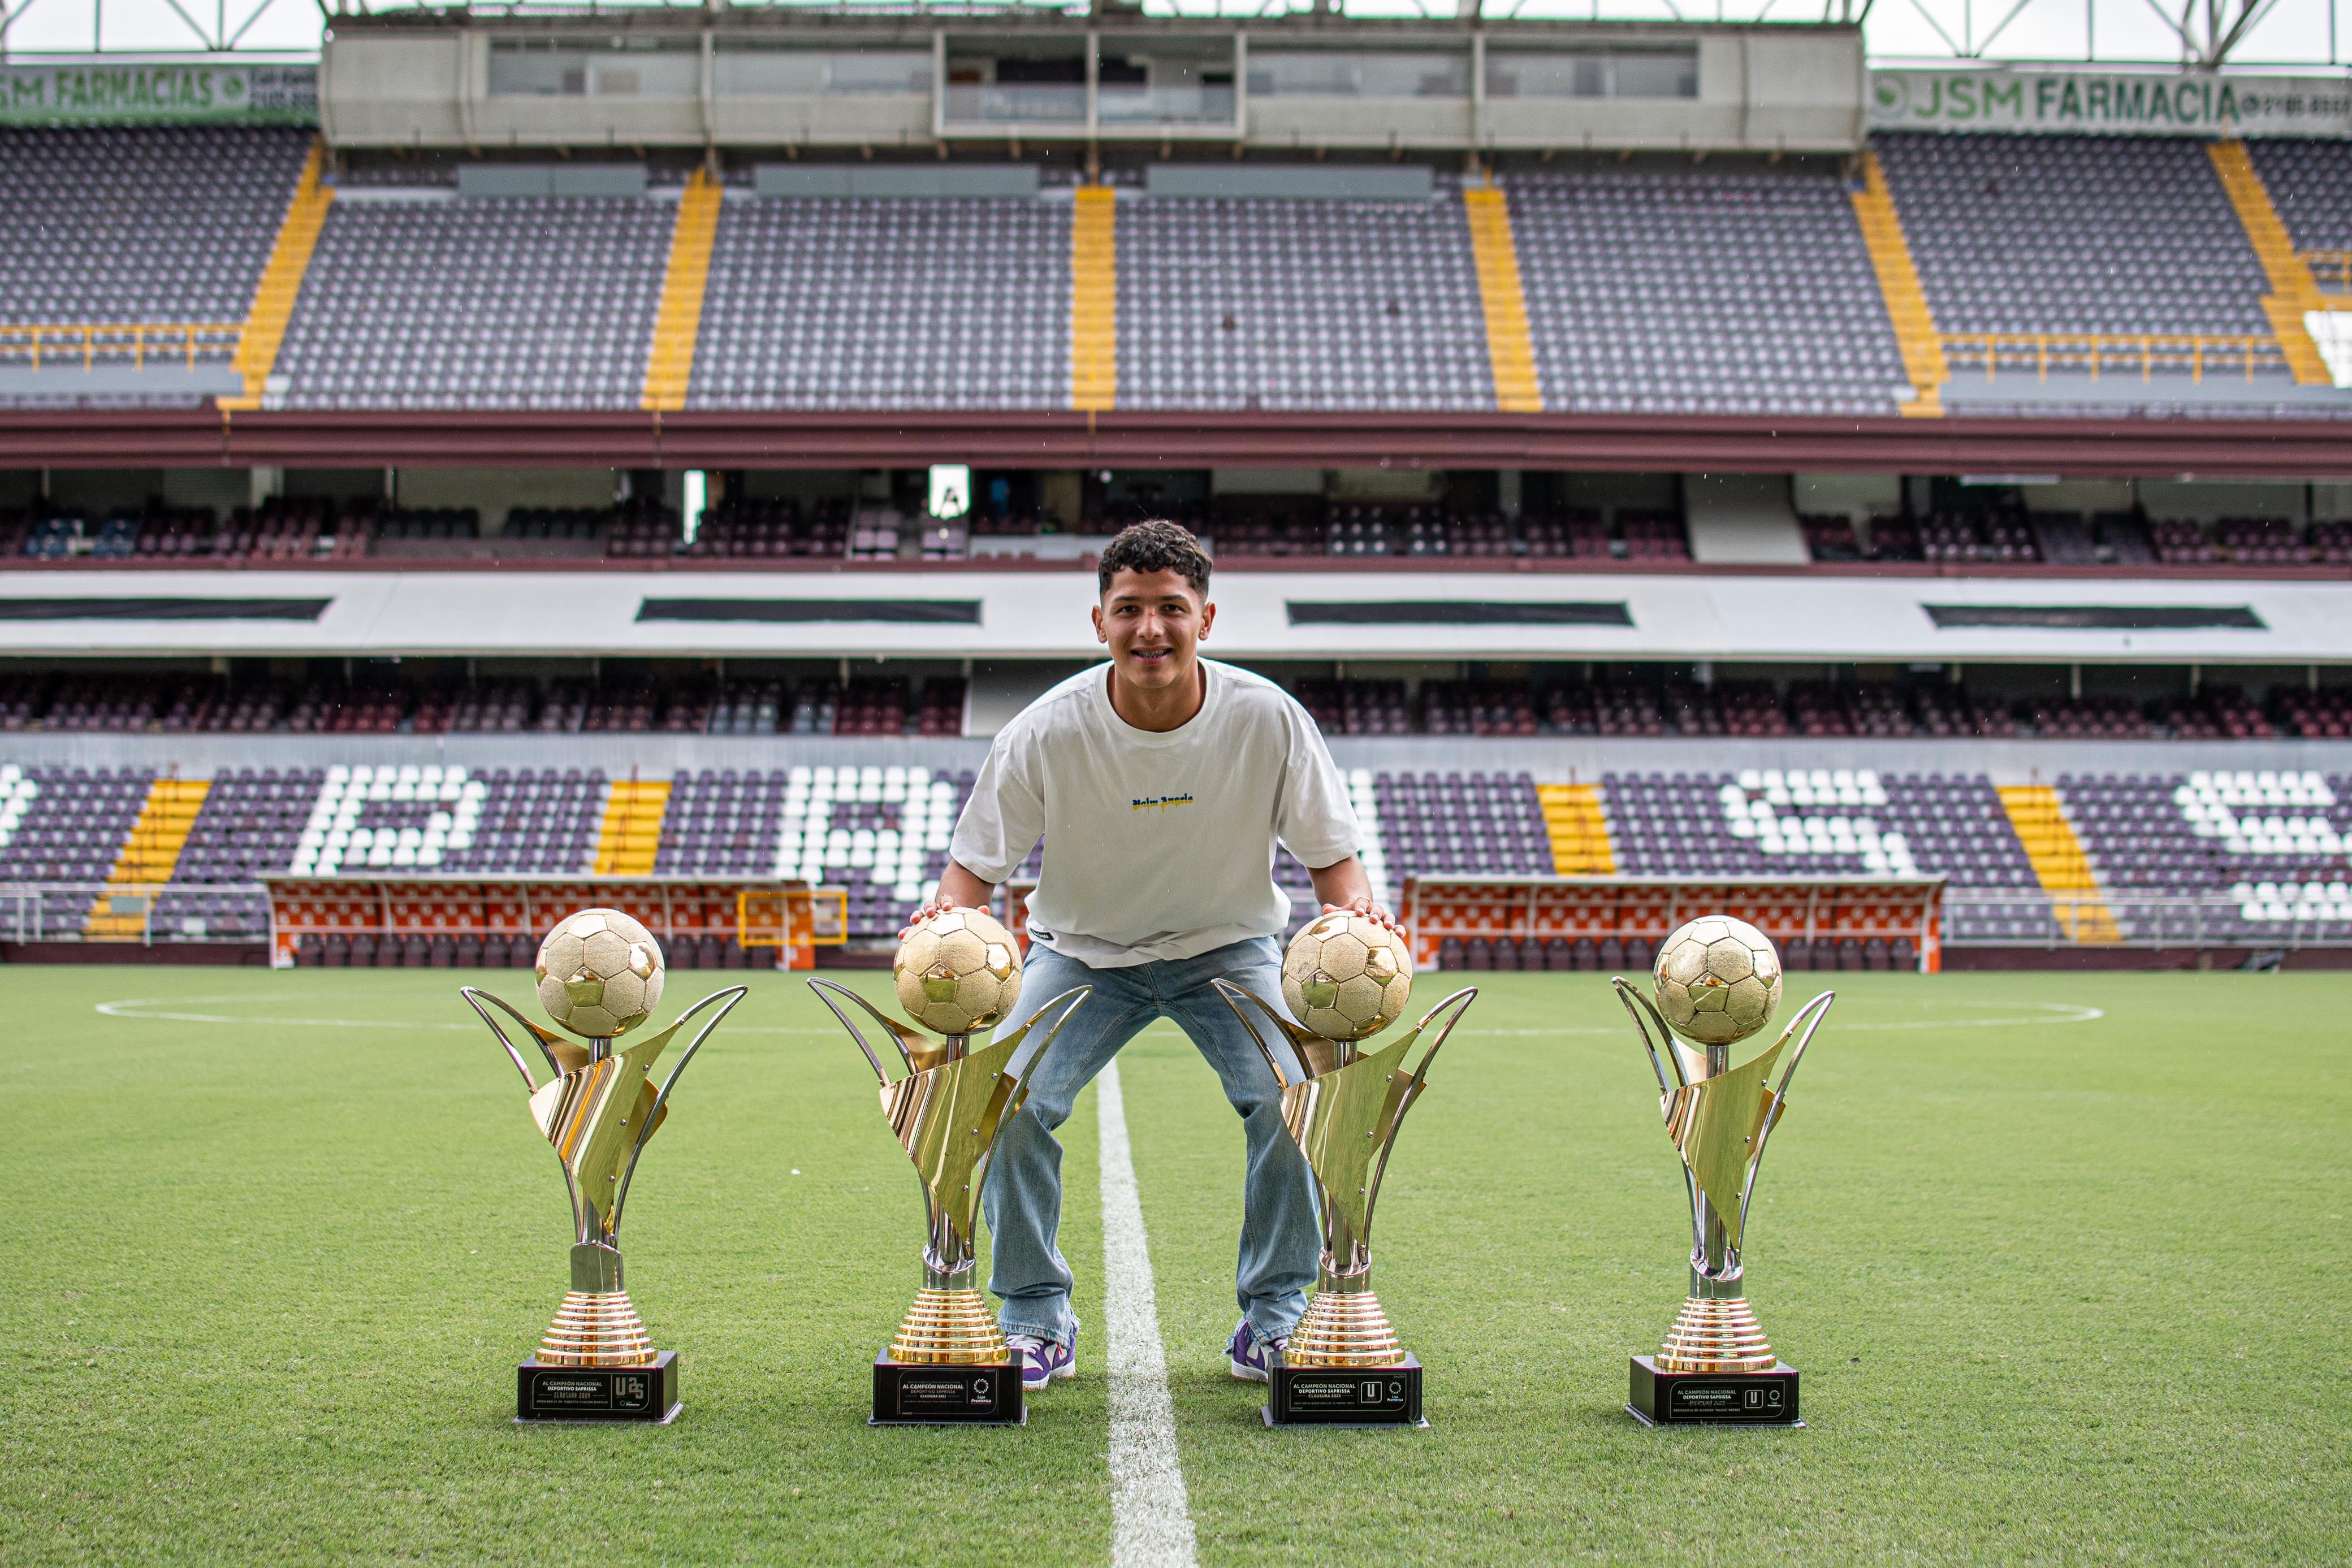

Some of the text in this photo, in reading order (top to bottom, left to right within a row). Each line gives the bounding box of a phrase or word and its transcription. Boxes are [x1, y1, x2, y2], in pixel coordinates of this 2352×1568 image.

[55, 70, 213, 108] FARMACIAS
[1913, 76, 2024, 120] JSM
[1367, 1384, 1375, 1397] U
[1750, 1392, 1758, 1404] U
